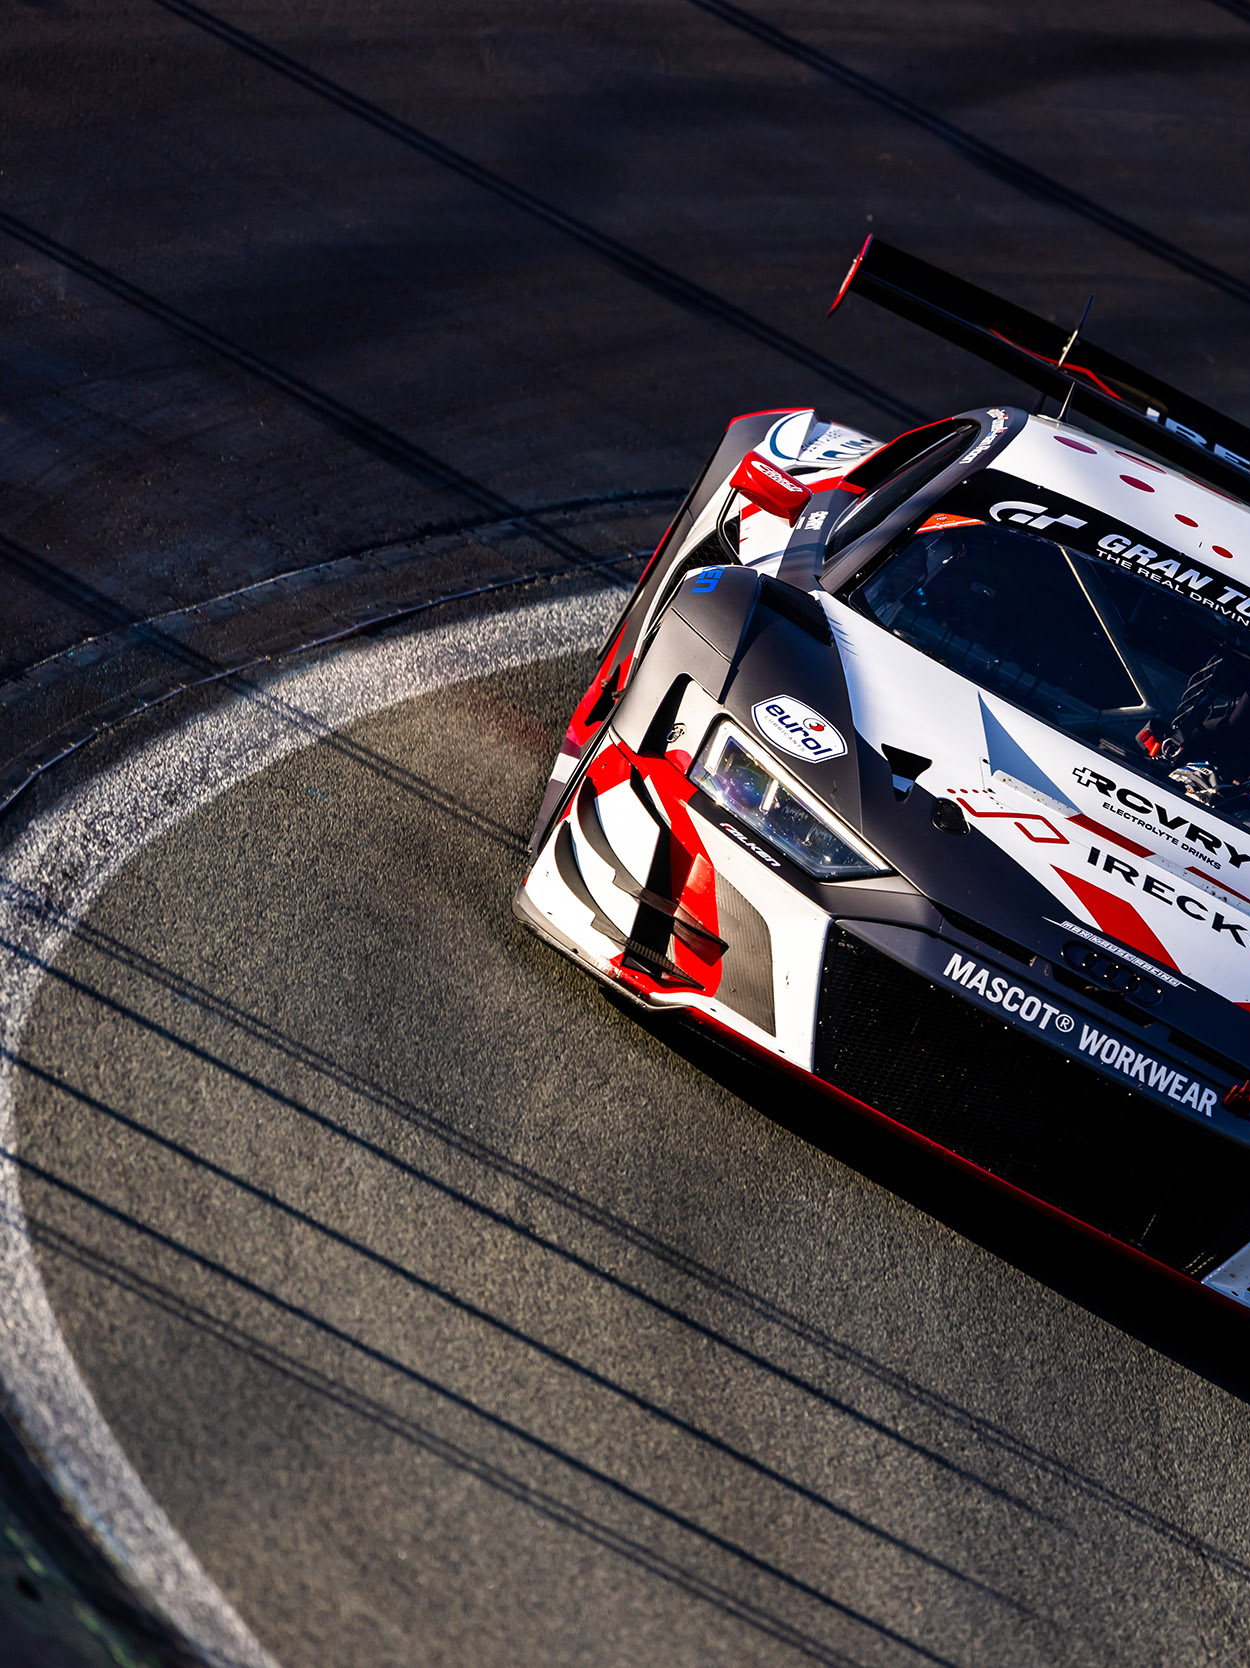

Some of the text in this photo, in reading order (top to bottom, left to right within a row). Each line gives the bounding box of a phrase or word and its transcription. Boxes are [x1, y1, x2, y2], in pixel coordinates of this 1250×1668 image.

[1096, 548, 1132, 570] THE
[1137, 567, 1185, 594] REAL
[1097, 533, 1214, 590] GRAN
[764, 715, 806, 752] LUBRICANTS
[765, 704, 833, 756] eurol
[1102, 801, 1222, 871] ELECTROLYTE DRINKS
[1079, 1023, 1218, 1117] WORKWEAR
